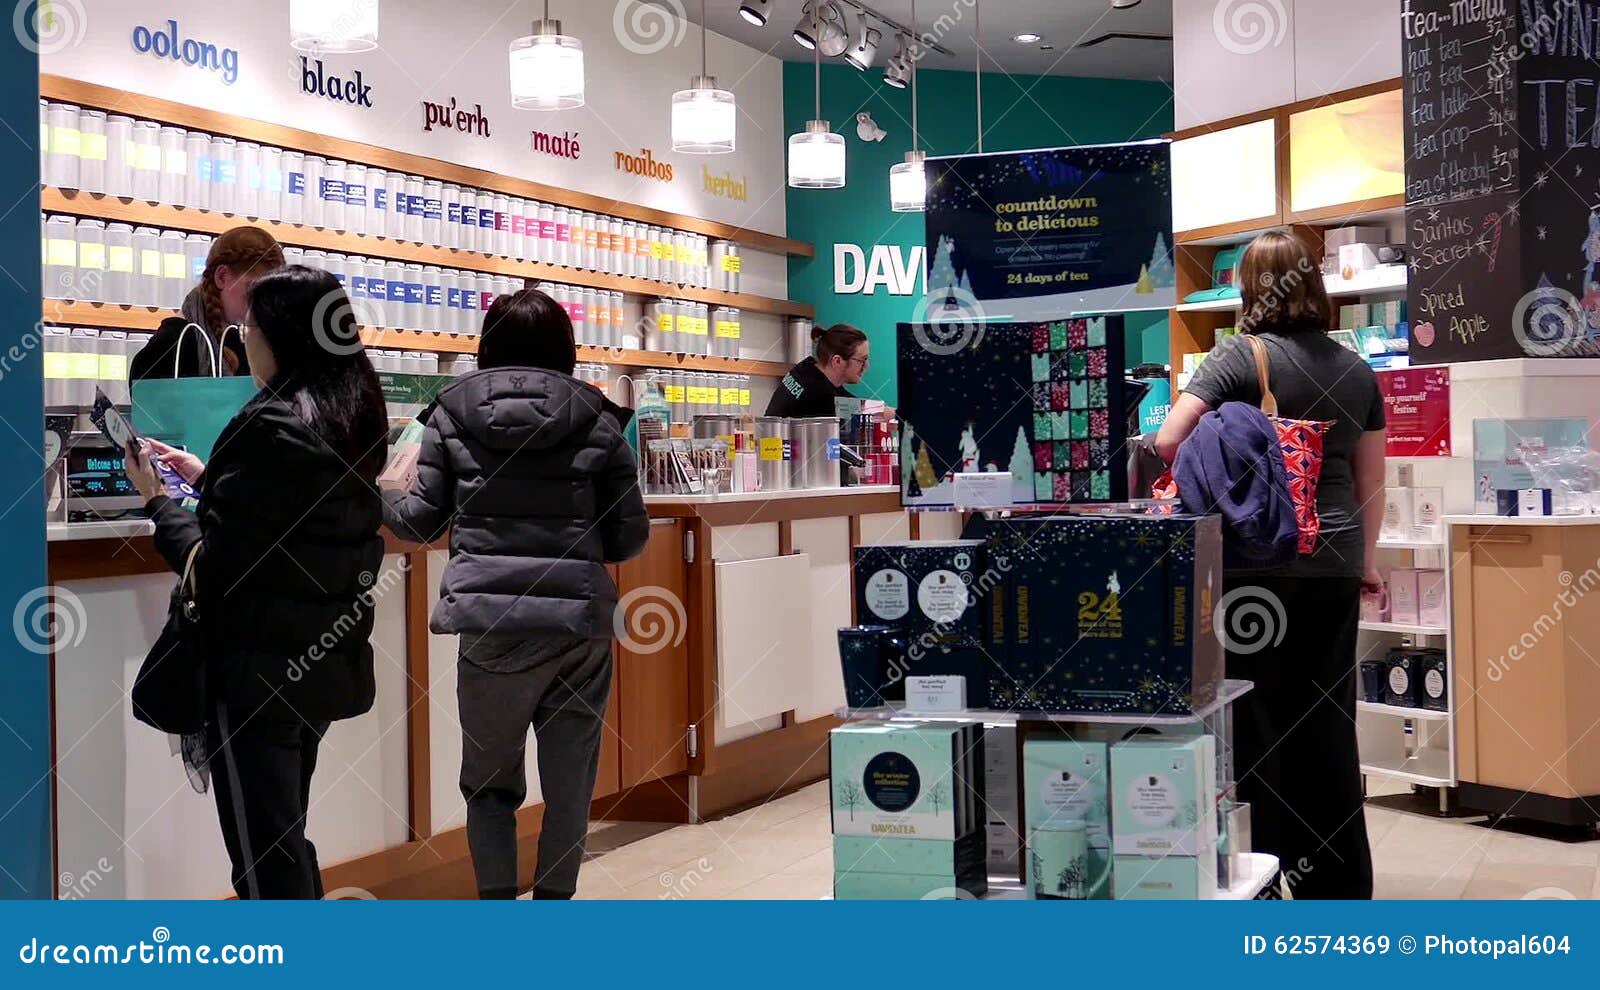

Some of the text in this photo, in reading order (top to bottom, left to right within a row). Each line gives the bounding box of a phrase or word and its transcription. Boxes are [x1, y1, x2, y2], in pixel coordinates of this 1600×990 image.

[132, 19, 239, 84] oolong
[1408, 38, 1433, 72] hot
[1440, 36, 1463, 62] tea
[299, 56, 374, 108] black
[1412, 71, 1432, 94] ice
[1439, 65, 1463, 87] tea
[423, 96, 491, 138] pu'erh
[1411, 97, 1435, 127] tea
[1522, 78, 1600, 149] TE
[531, 130, 581, 160] maté
[1413, 132, 1438, 160] tea
[1442, 126, 1470, 157] pop
[614, 148, 673, 182] rooibos
[703, 165, 747, 201] herbal
[1406, 174, 1432, 199] tea
[995, 195, 1098, 214] countdown
[995, 213, 1100, 232] to delicious
[1422, 240, 1474, 270] Secret
[1007, 270, 1090, 285] 24 days of tea
[1419, 284, 1465, 317] Spiced
[1449, 313, 1490, 344] Apple
[1149, 405, 1165, 416] LES
[1396, 391, 1428, 404] yourself
[87, 457, 111, 471] Welcome
[113, 458, 121, 470] to
[1077, 591, 1122, 621] 24
